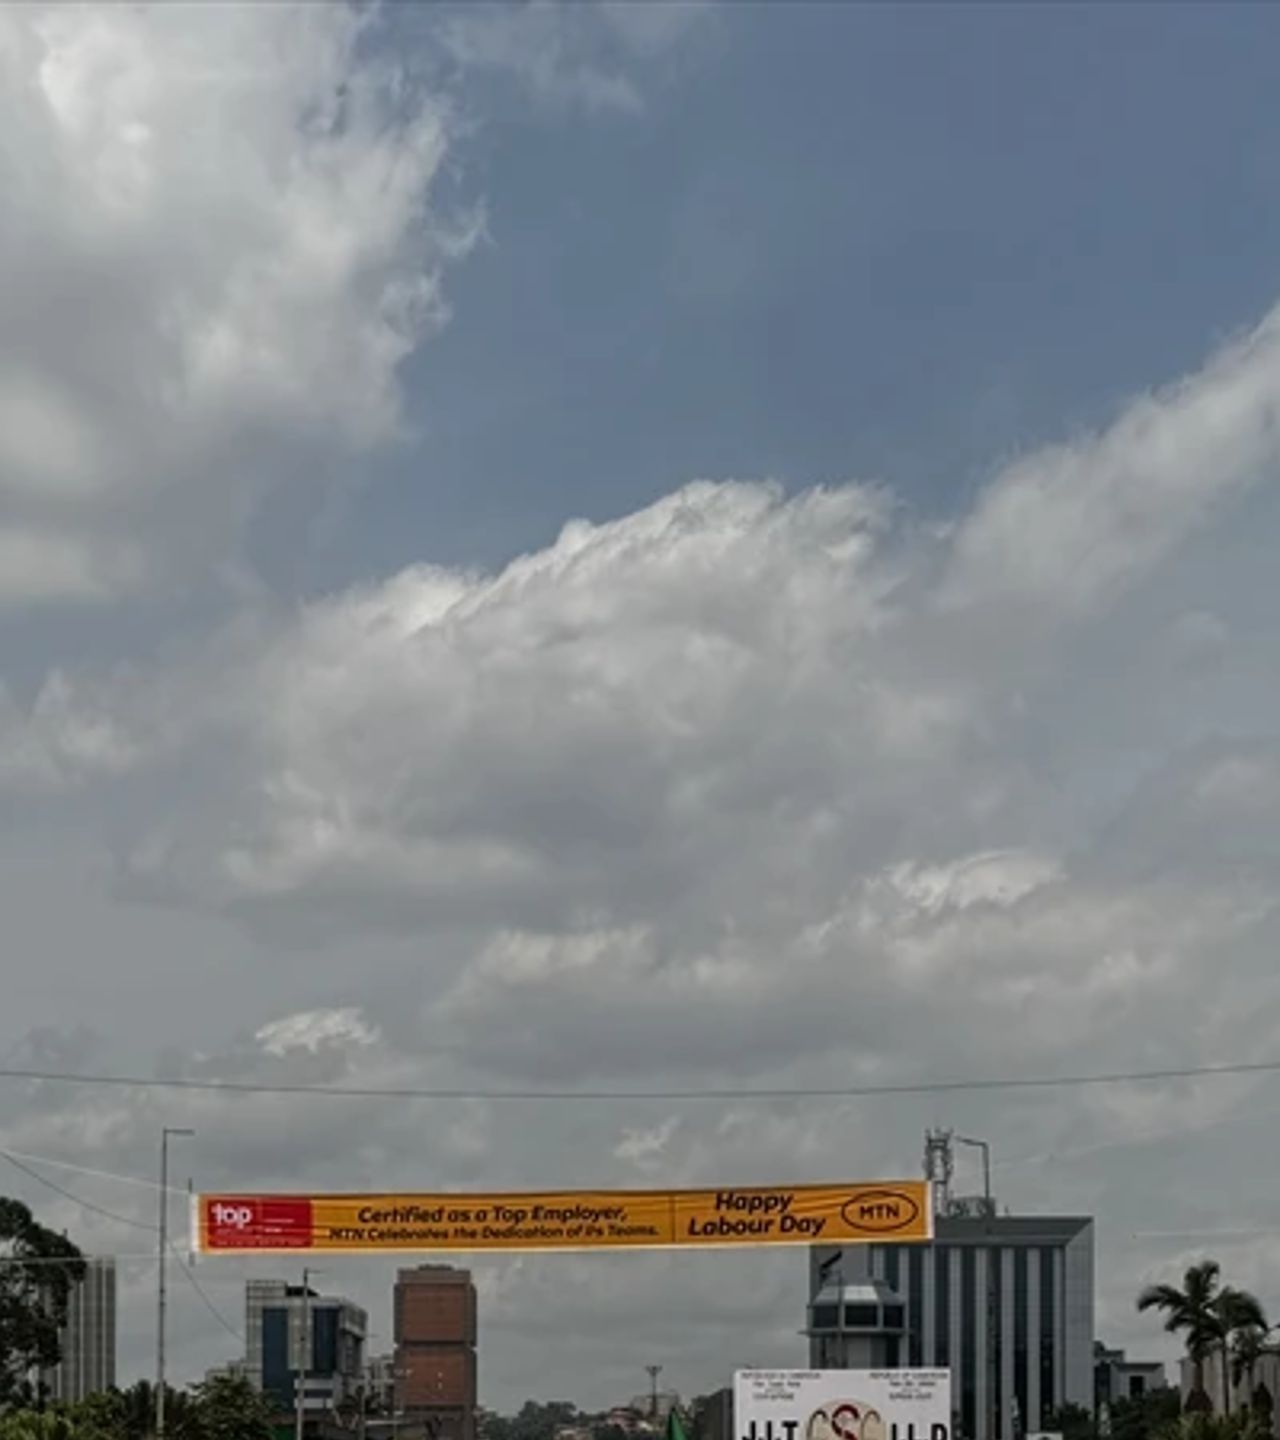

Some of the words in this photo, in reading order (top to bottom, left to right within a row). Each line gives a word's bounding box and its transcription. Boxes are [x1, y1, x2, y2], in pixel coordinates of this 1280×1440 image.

[357, 1205, 445, 1223] Certified
[448, 1208, 471, 1222] as
[475, 1208, 487, 1221] a
[493, 1205, 527, 1224] Top
[531, 1203, 627, 1223] Employer,
[715, 1191, 794, 1215] Happy
[860, 1204, 900, 1220] MTN
[211, 1202, 252, 1229] top
[688, 1216, 775, 1237] Labour
[780, 1214, 827, 1237] Day
[328, 1227, 366, 1241] MTN
[368, 1226, 450, 1241] Celebrates
[454, 1225, 478, 1239] the
[481, 1224, 564, 1239] Dedication
[566, 1223, 584, 1239] of
[608, 1223, 660, 1237] Teams.
